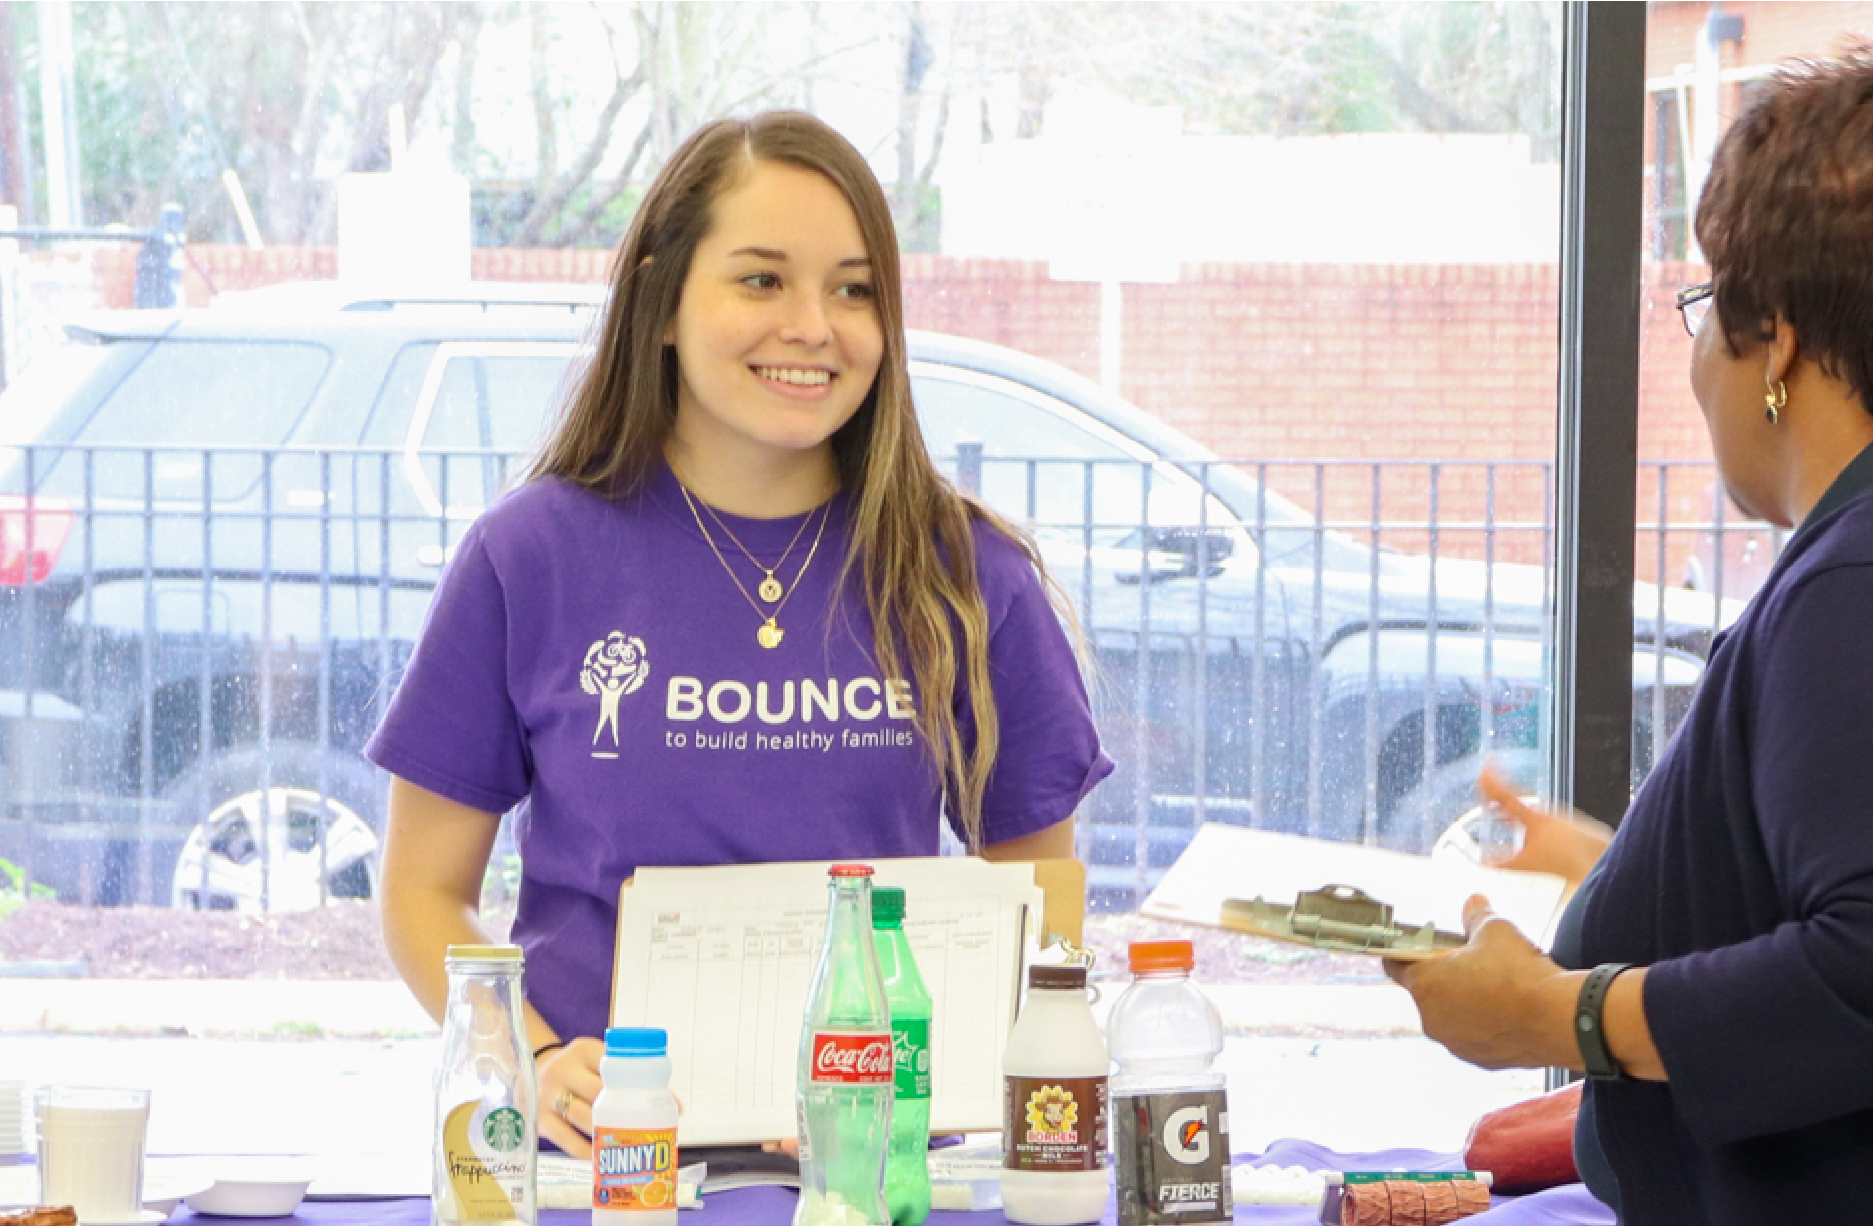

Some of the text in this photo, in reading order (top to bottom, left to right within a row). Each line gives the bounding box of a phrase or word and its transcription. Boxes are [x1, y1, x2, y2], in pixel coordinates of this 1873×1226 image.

[666, 676, 916, 724] BOUNCE
[665, 728, 913, 753] to build healthy families
[817, 1041, 891, 1073] Coca-Cola
[1163, 1105, 1210, 1165] G
[1159, 1182, 1220, 1202] FIERCE
